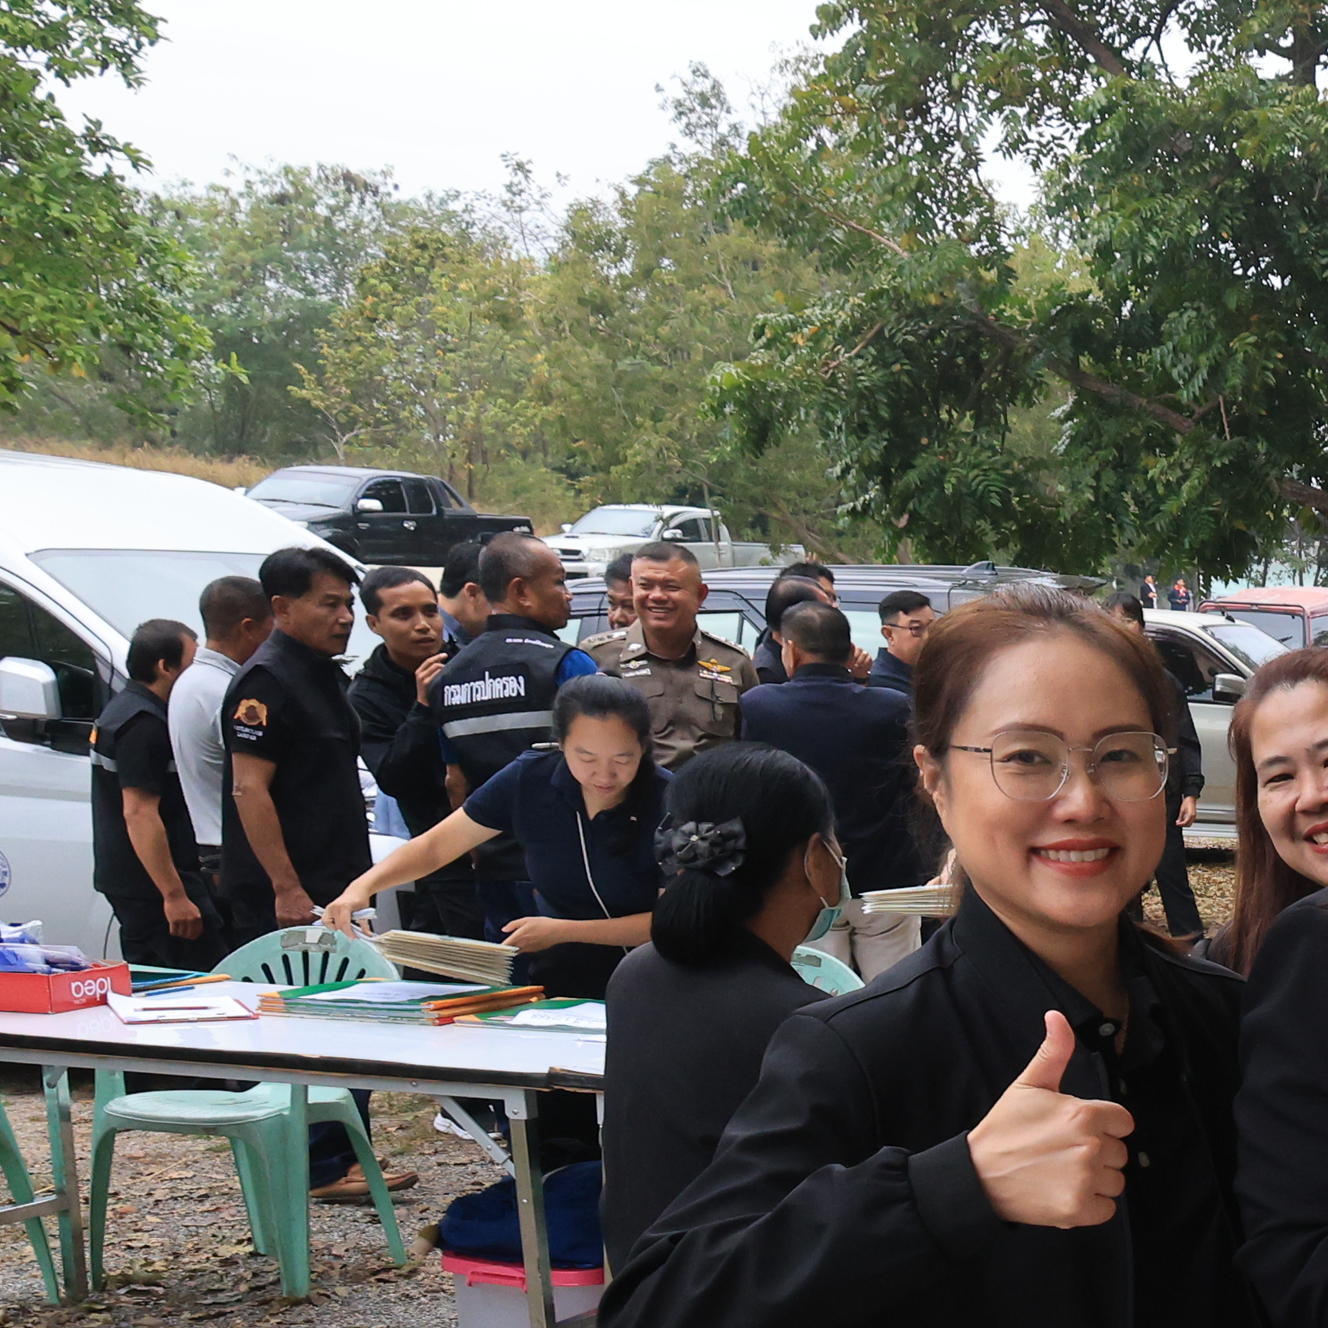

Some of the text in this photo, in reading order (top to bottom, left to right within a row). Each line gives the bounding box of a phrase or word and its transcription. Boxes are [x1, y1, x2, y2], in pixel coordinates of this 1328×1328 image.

[444, 671, 525, 706] กรมการปกครอง
[70, 976, 112, 1002] idea
